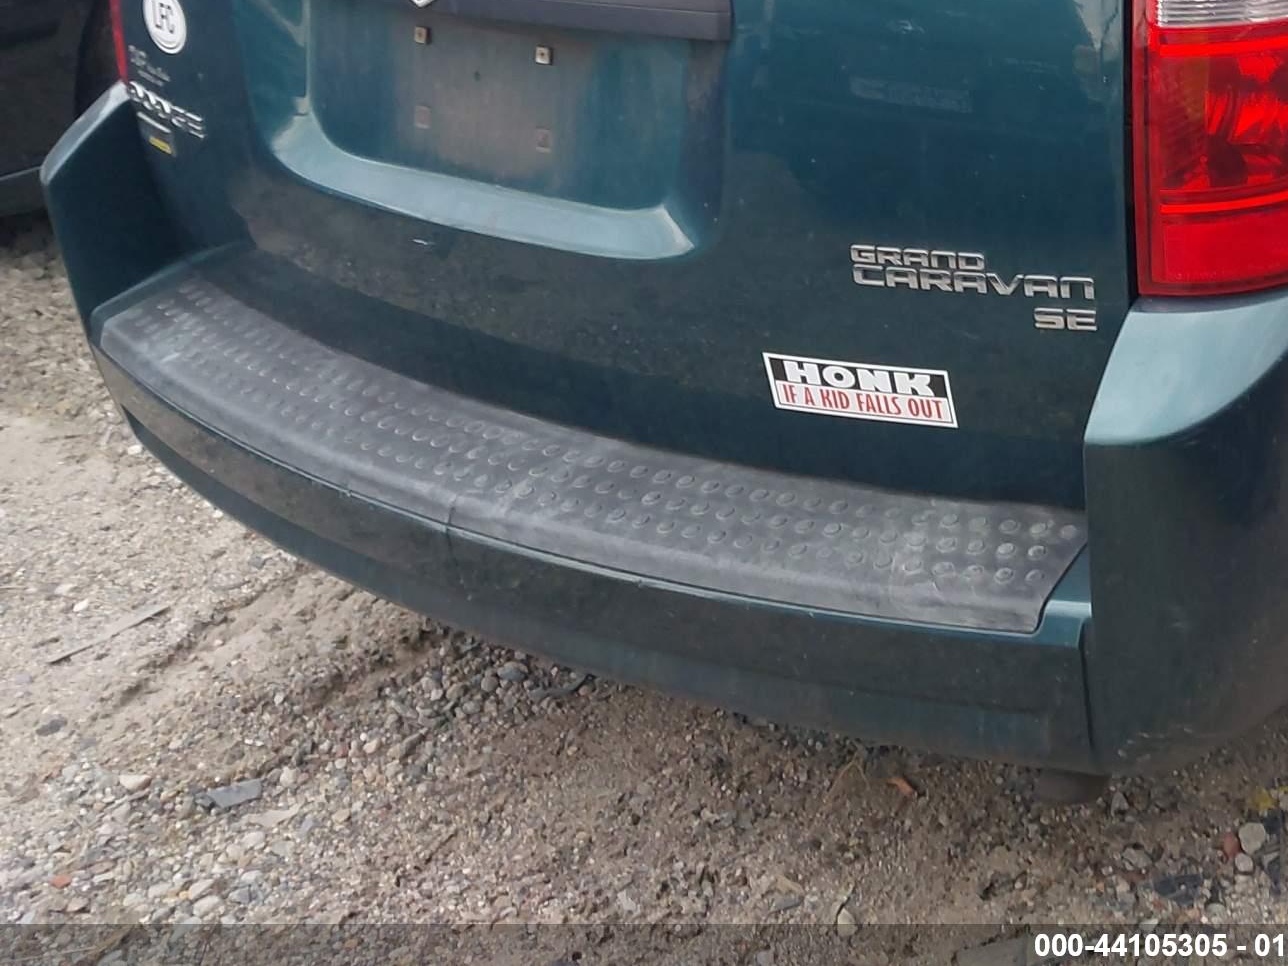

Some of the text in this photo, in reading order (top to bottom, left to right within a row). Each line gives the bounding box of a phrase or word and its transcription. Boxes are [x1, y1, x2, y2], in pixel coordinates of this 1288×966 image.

[850, 244, 986, 271] GRAND
[852, 264, 1095, 300] CARAVAN
[1033, 307, 1098, 332] SE
[783, 360, 935, 397] HONK
[783, 384, 943, 419] IF A KID FALLS OUT
